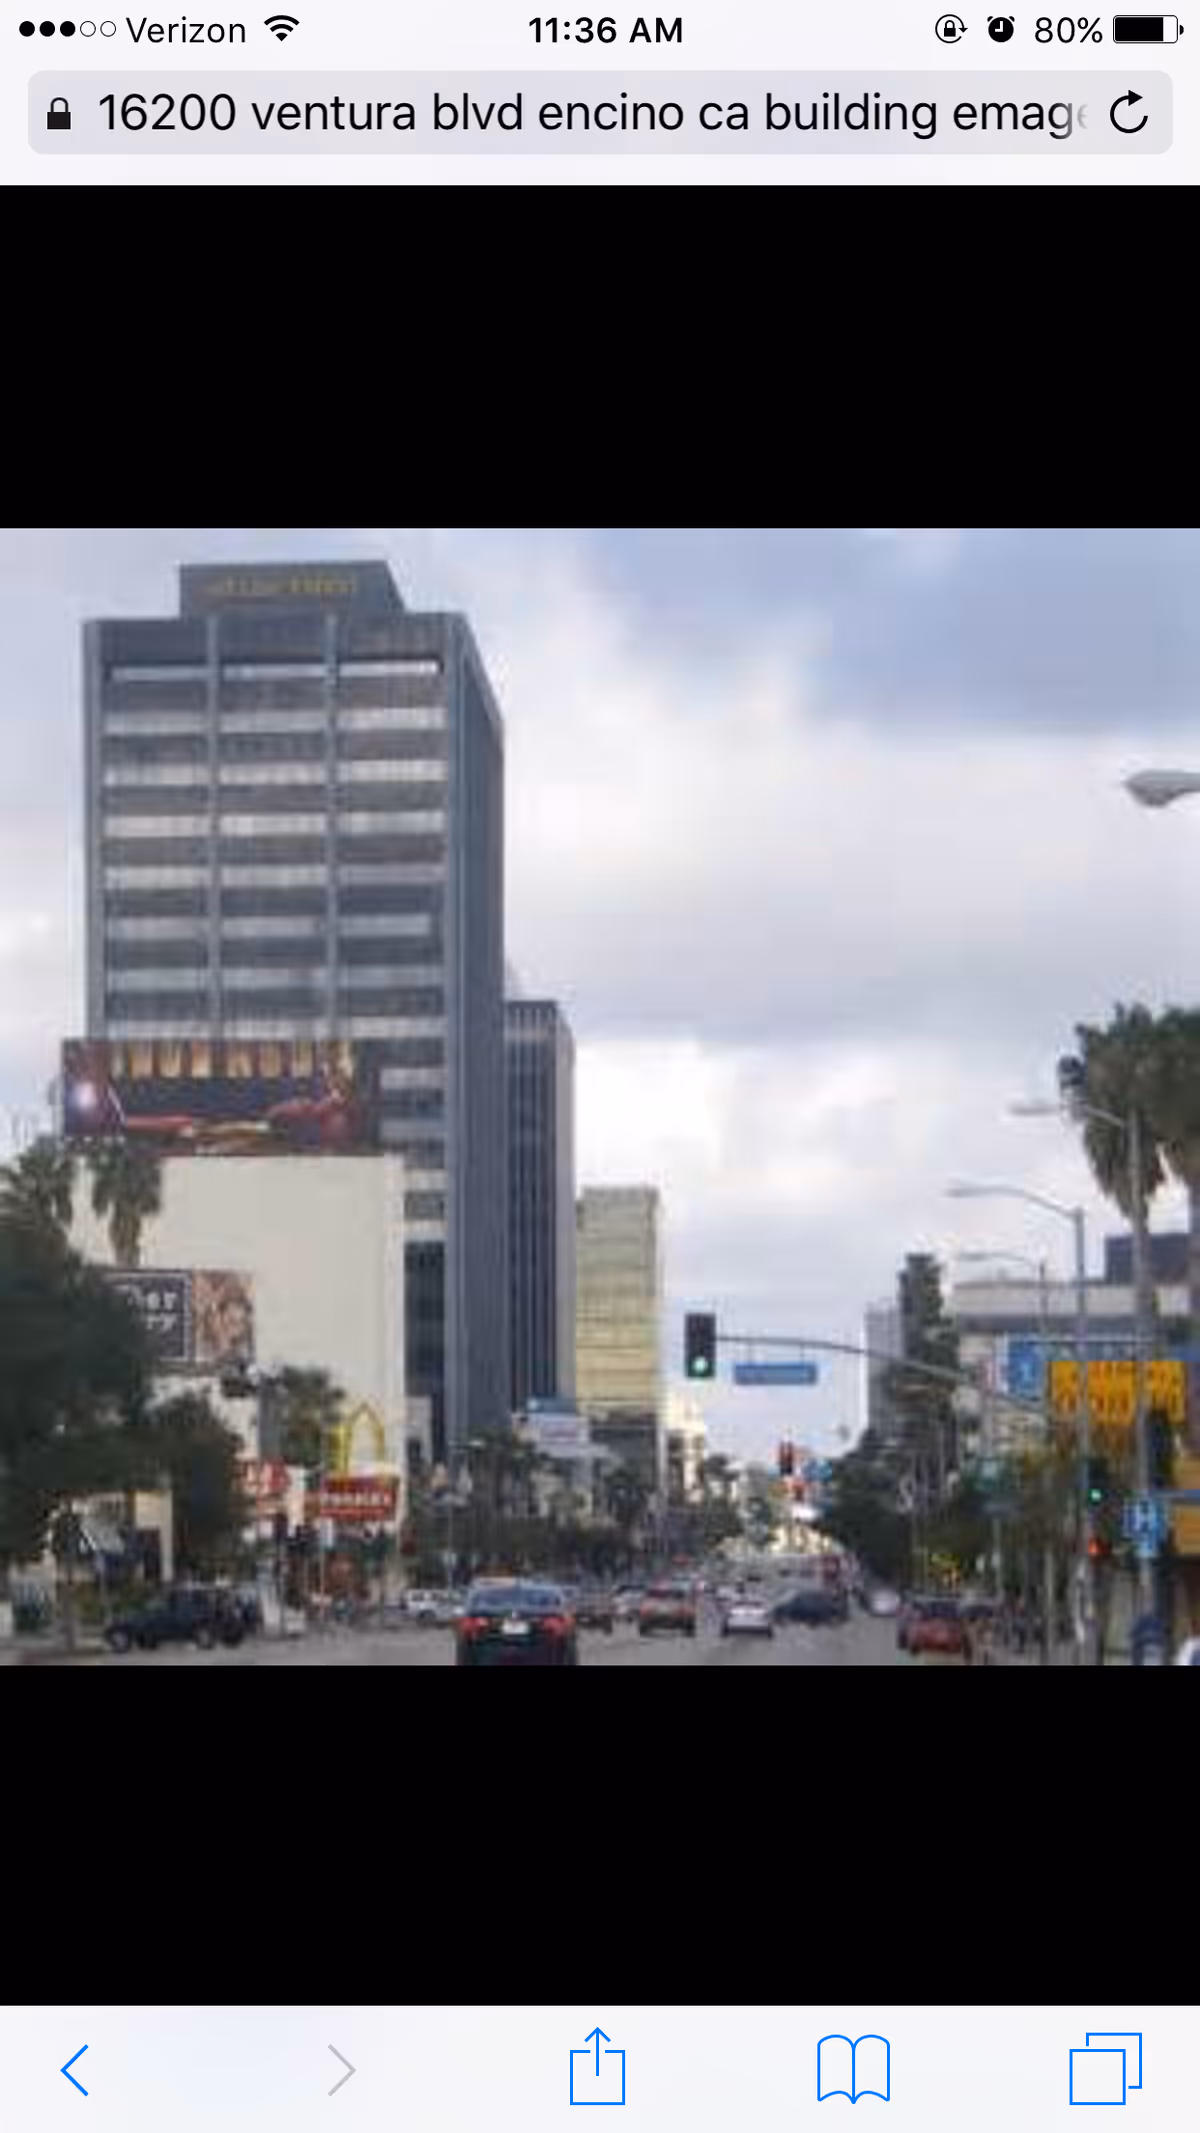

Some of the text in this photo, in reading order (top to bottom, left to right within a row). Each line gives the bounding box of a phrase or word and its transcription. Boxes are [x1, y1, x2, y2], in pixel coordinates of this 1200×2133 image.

[126, 16, 246, 44] Verizon
[528, 16, 683, 44] 11:36 AM
[1034, 16, 1103, 44] 80%
[99, 92, 237, 132] 16200
[250, 95, 416, 131] ventura
[433, 91, 523, 131] blvd
[538, 91, 685, 131] encino
[698, 102, 749, 131] ca
[765, 91, 937, 140] building
